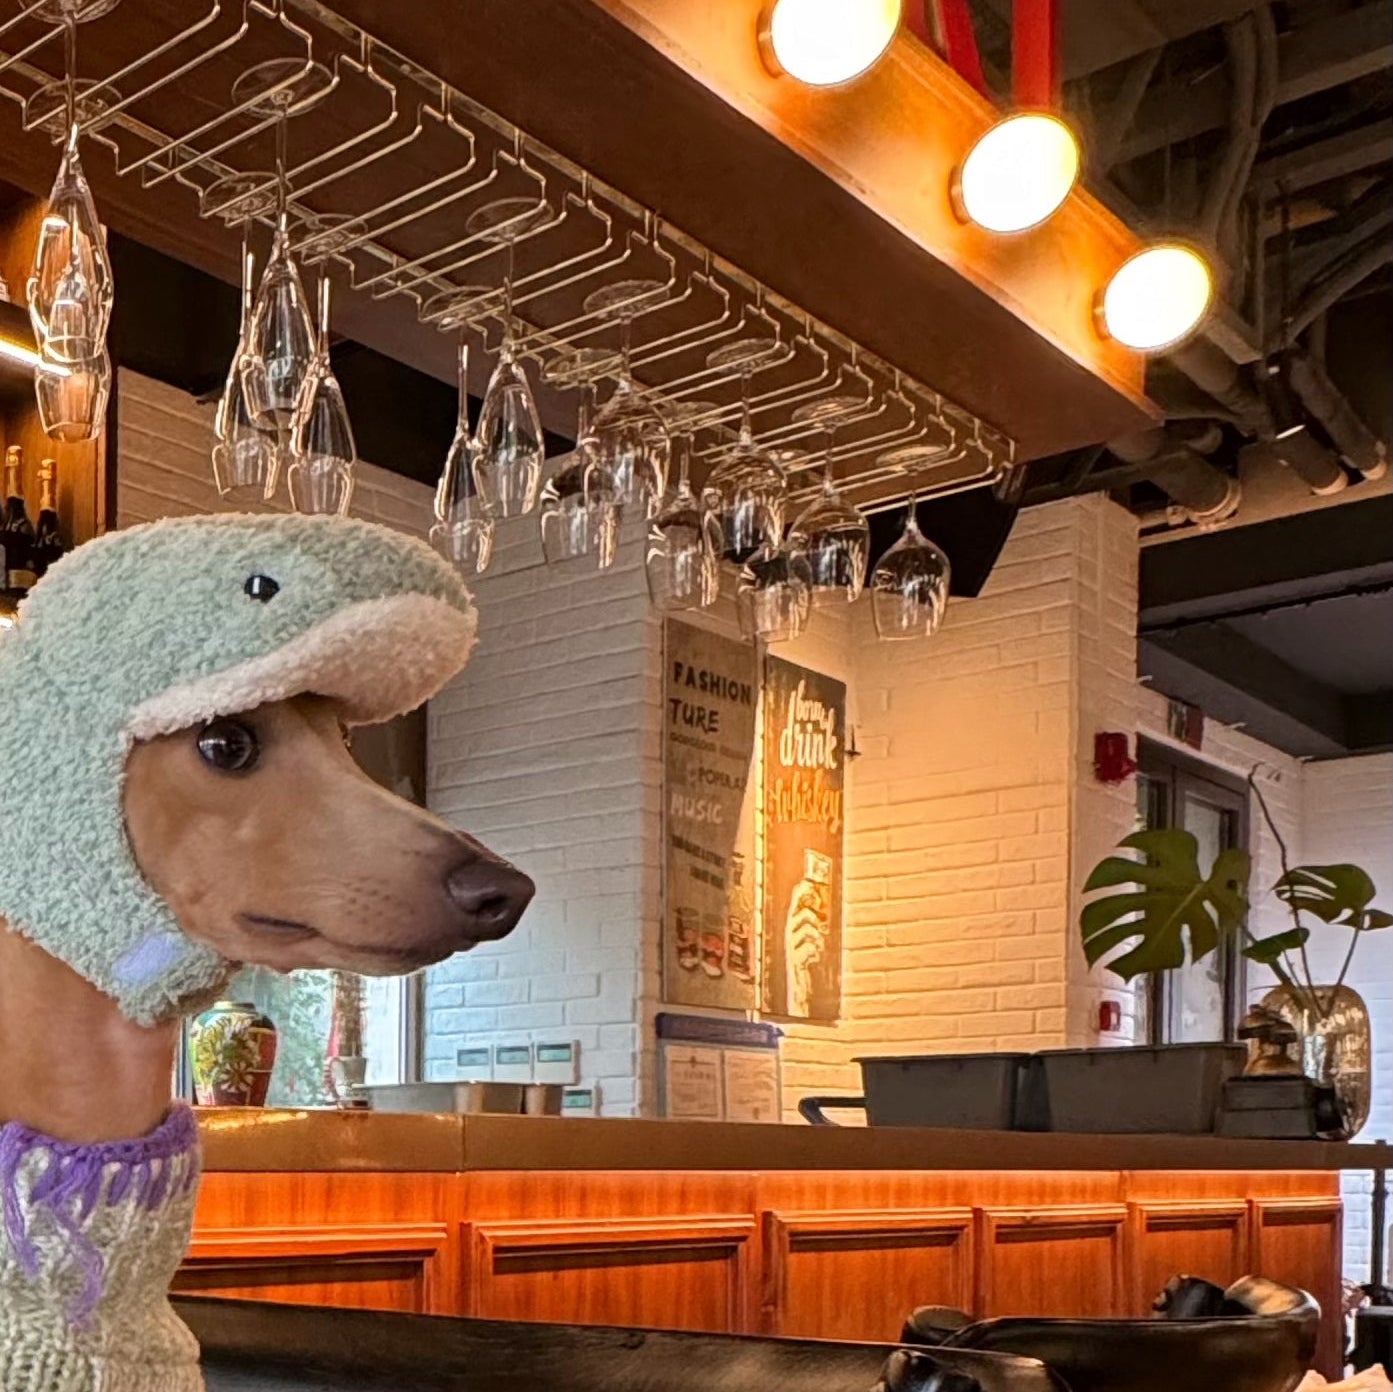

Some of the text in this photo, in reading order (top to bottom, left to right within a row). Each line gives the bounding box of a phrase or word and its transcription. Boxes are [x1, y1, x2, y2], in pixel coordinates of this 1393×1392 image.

[673, 661, 752, 706] FASHION
[668, 698, 719, 735] TURE
[780, 690, 837, 769] drink
[671, 793, 723, 824] MUSIC
